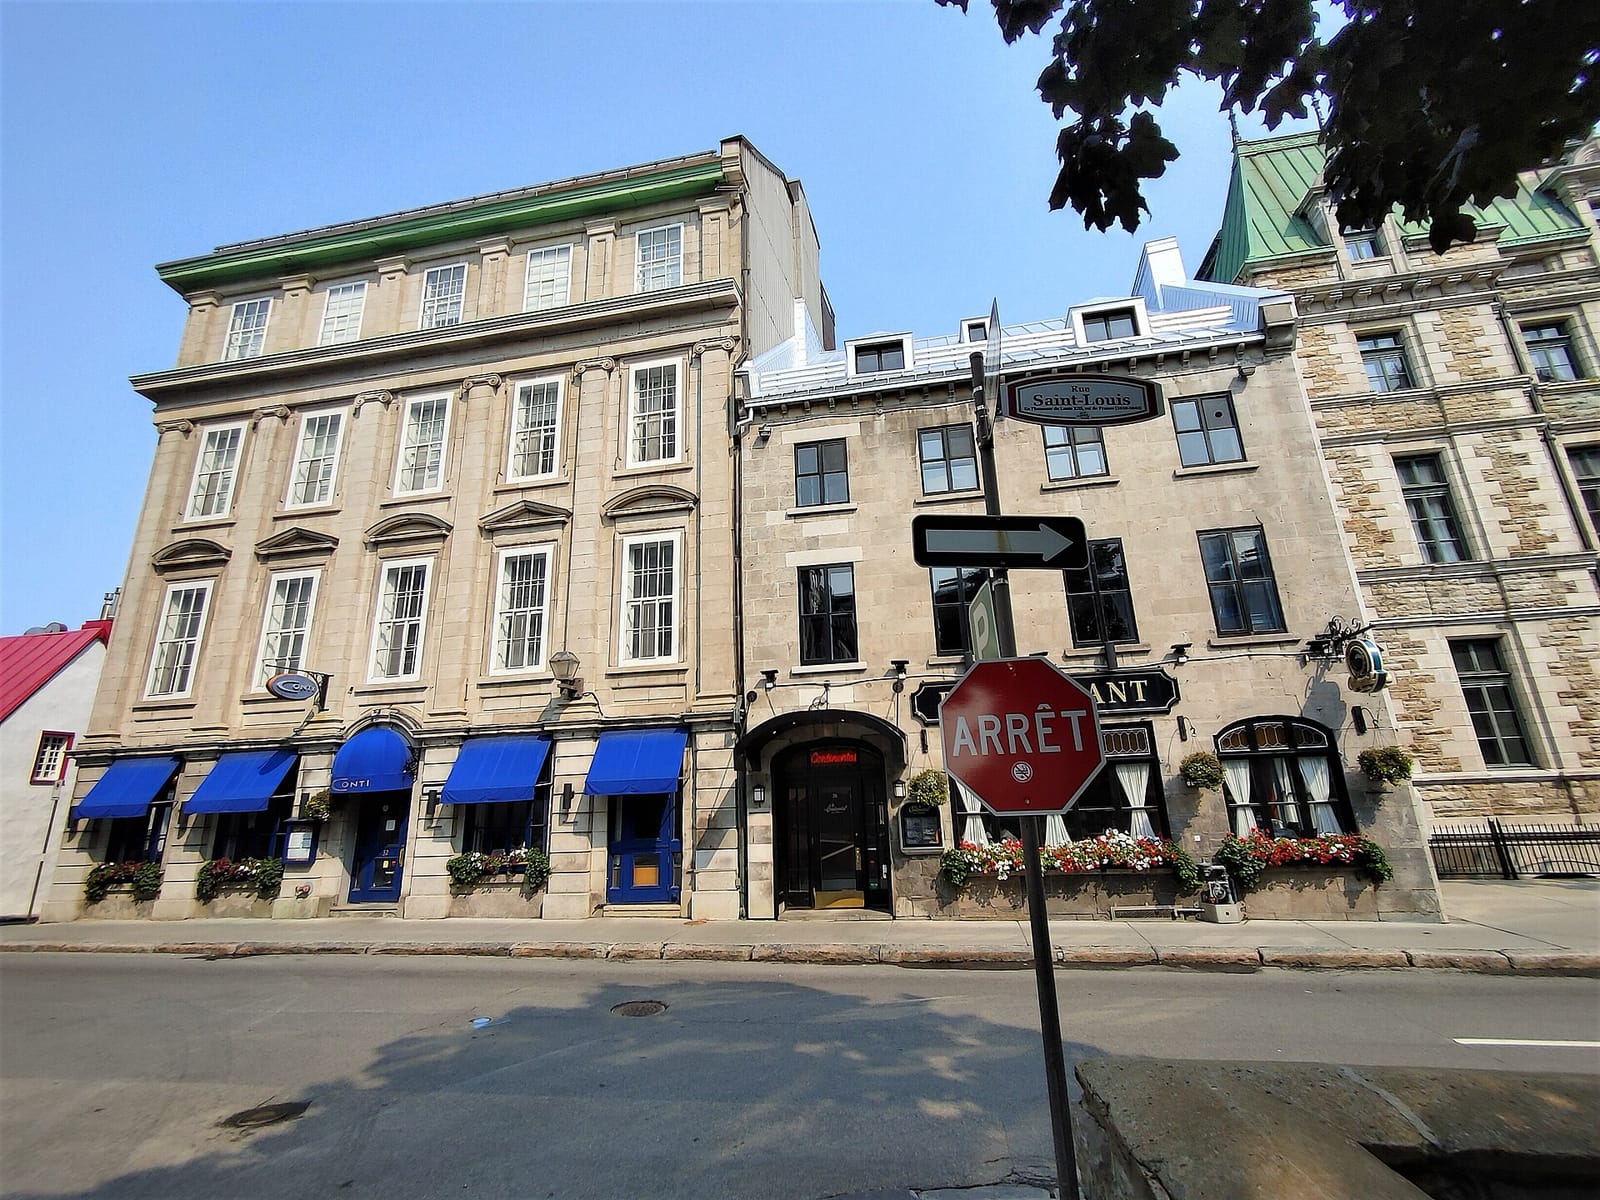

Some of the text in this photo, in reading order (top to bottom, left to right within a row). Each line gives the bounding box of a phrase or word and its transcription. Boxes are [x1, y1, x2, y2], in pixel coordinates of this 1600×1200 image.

[1071, 385, 1090, 393] Rue
[1033, 394, 1131, 407] Saint-Louis
[952, 703, 1087, 757] ARRÊT
